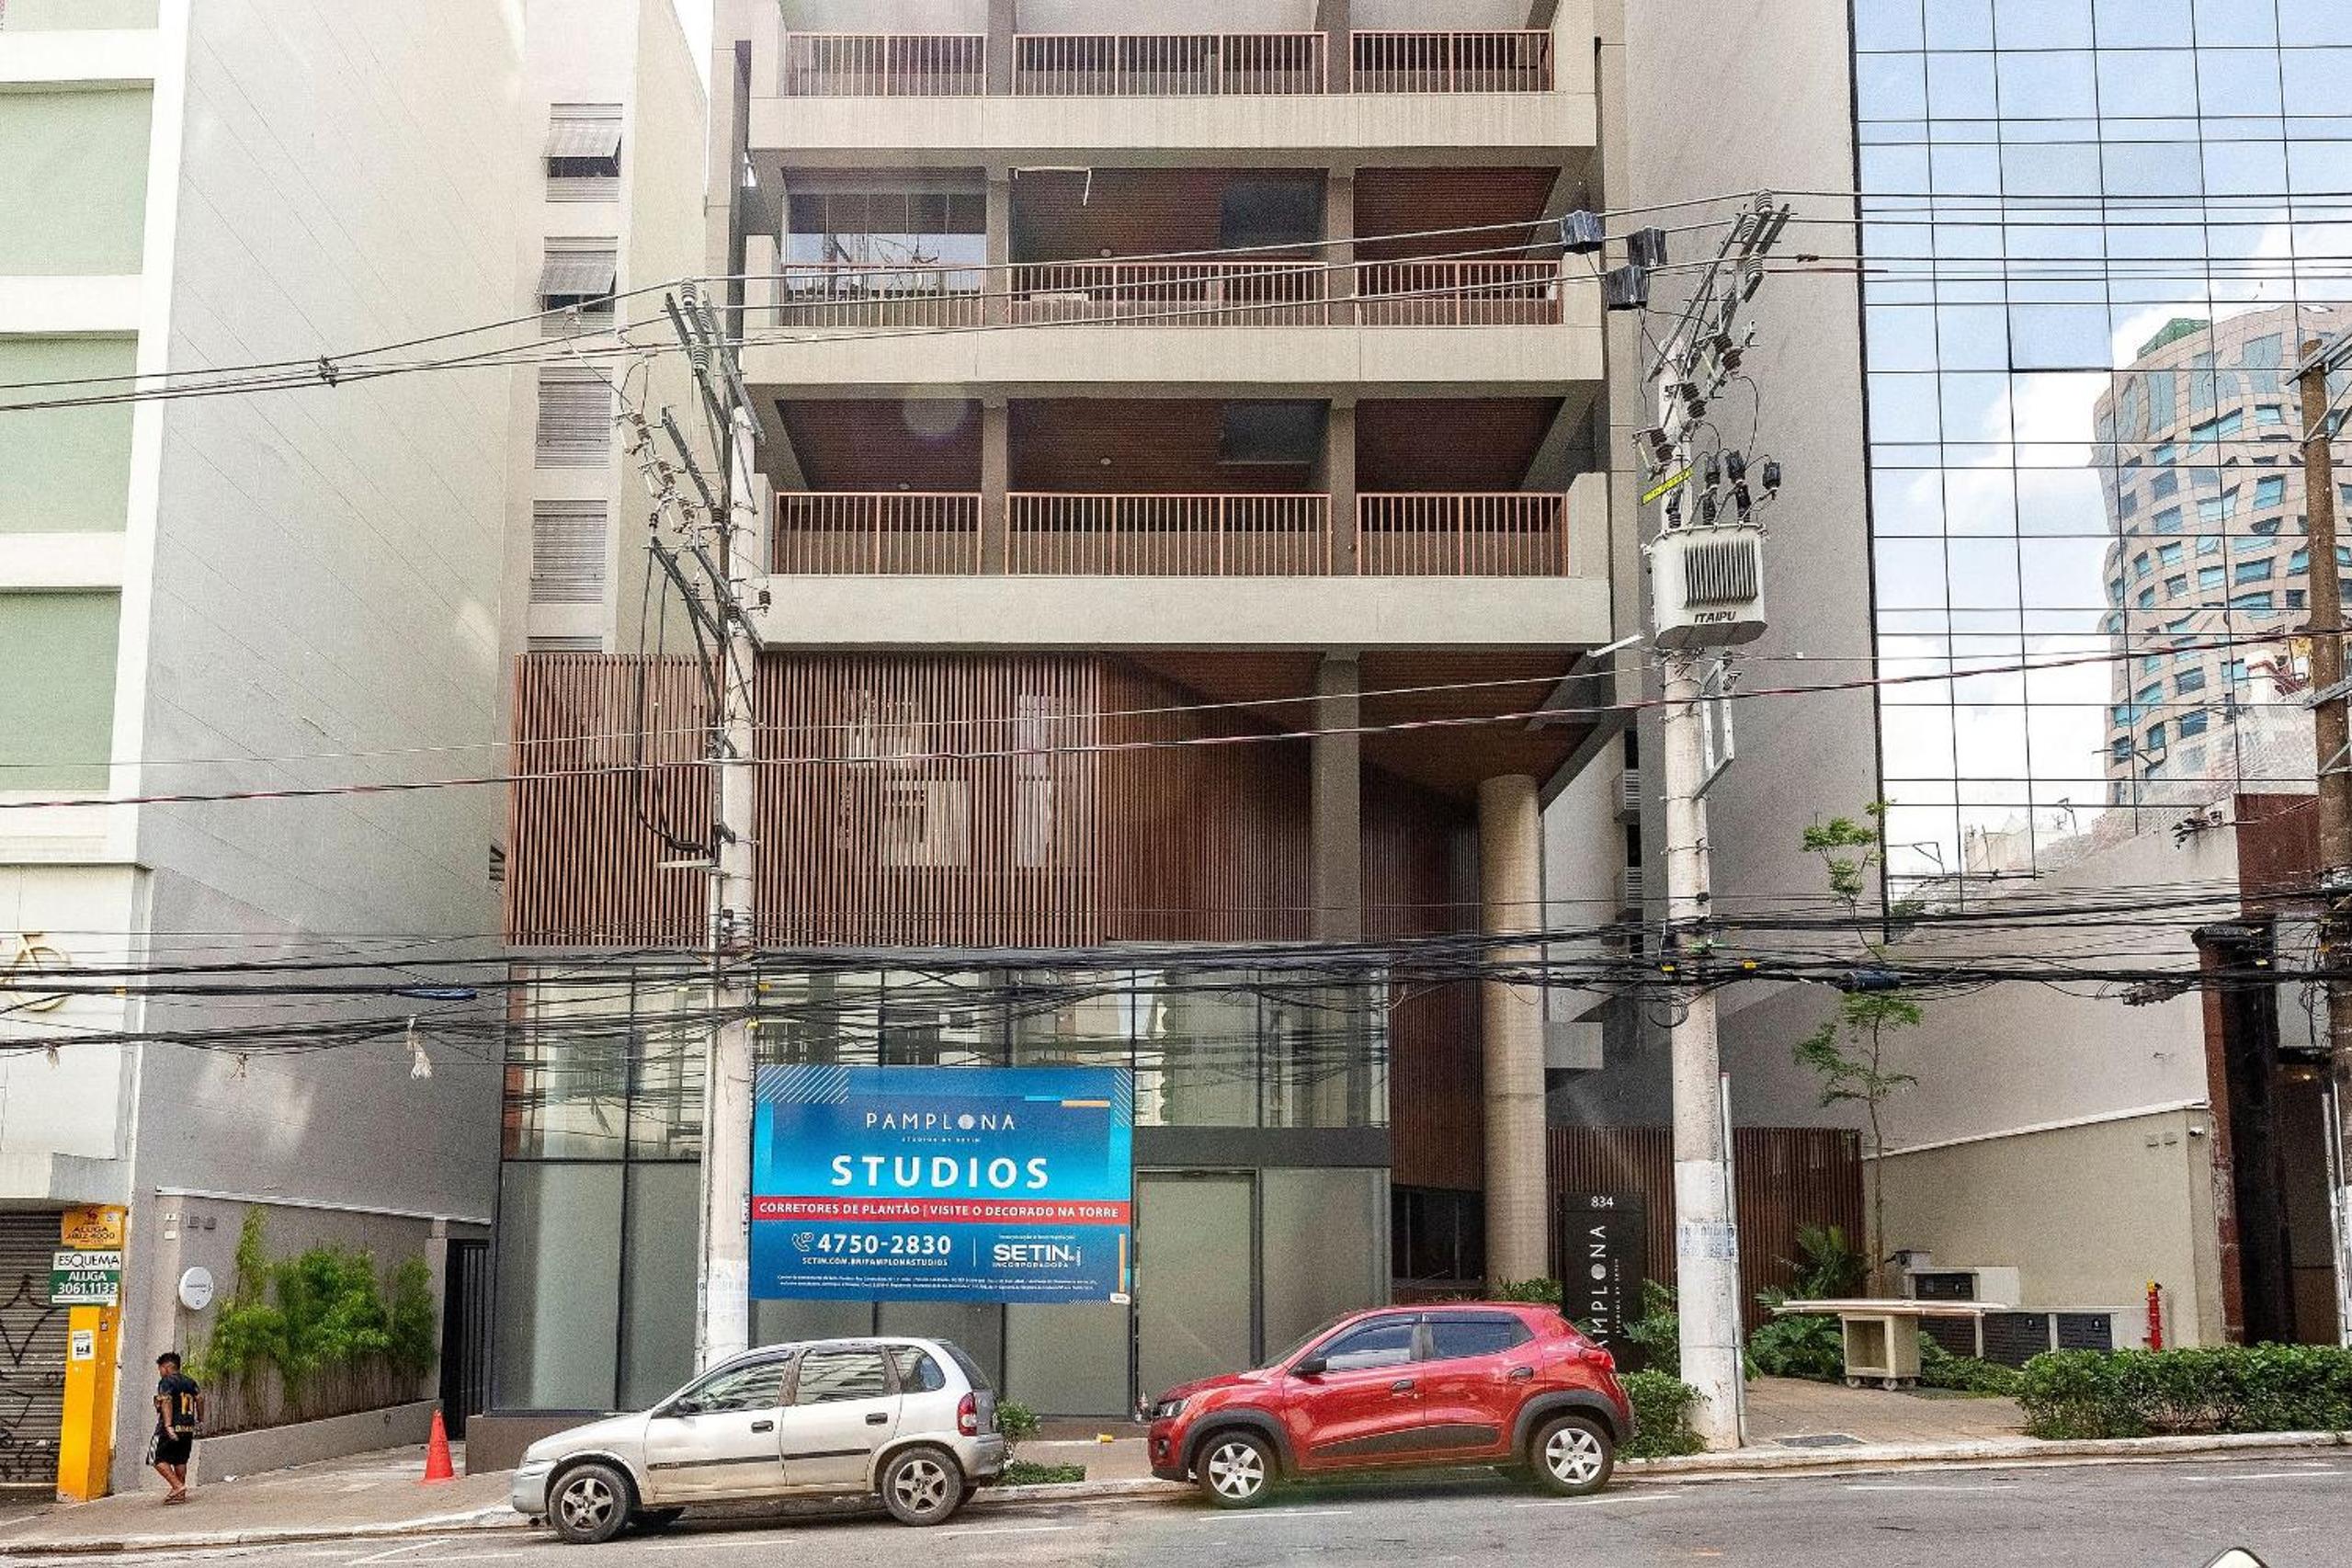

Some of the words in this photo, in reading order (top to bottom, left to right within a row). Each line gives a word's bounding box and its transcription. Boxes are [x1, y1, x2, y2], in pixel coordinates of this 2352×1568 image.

[1694, 610, 1736, 623] ITAIPU
[866, 1112, 1016, 1131] PAMPLONA
[831, 1154, 1050, 1190] STUDIOS
[1591, 1196, 1614, 1208] 834
[759, 1202, 839, 1215] CORRETORES
[843, 1205, 858, 1215] DE
[862, 1203, 920, 1215] PLANTÃO
[929, 1204, 969, 1216] VISITE
[972, 1205, 982, 1216] O
[985, 1206, 1054, 1217] DECORADO
[1058, 1206, 1075, 1217] NA
[1079, 1207, 1119, 1218] TORRE
[817, 1233, 951, 1255] 4750-2830
[993, 1243, 1069, 1262] SETIN
[58, 1254, 120, 1268] ESQUEMA
[67, 1271, 108, 1281] ALUGA
[57, 1281, 119, 1295] 3061.1133
